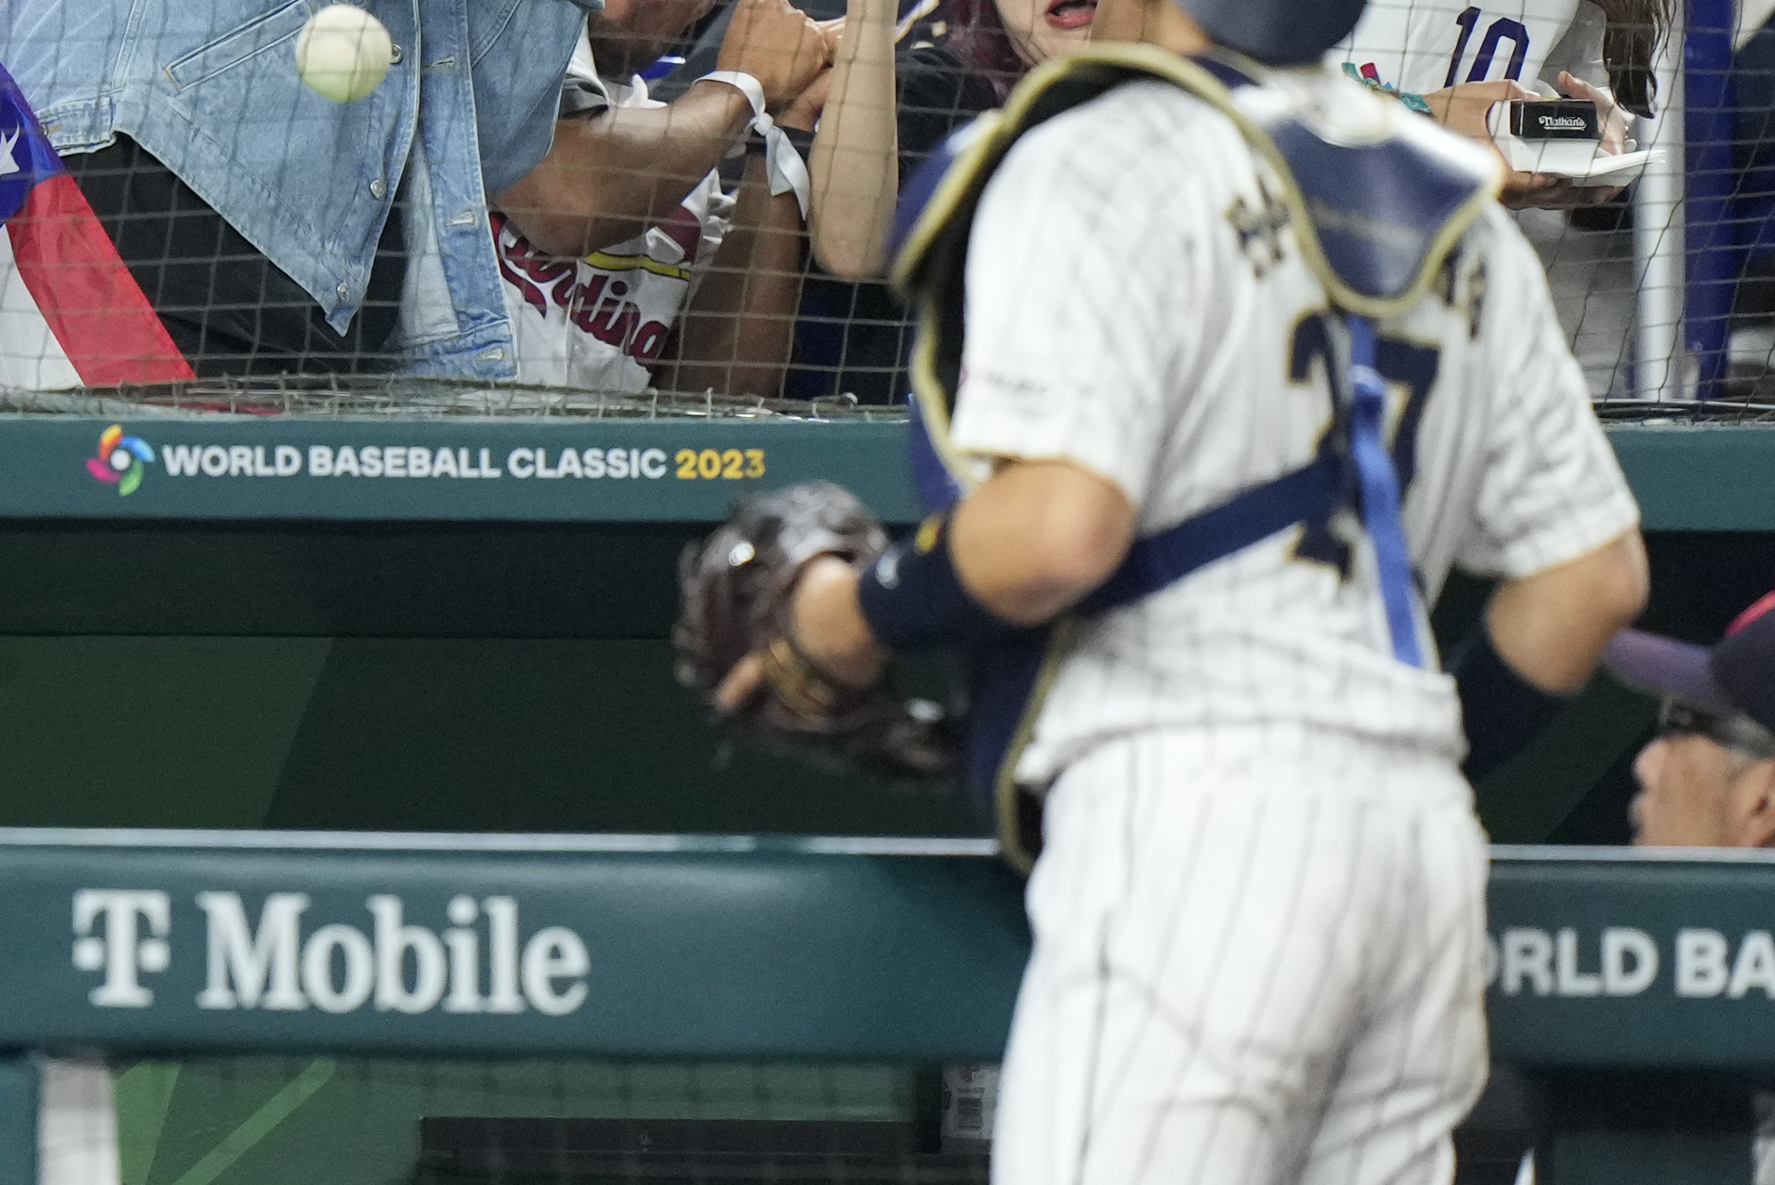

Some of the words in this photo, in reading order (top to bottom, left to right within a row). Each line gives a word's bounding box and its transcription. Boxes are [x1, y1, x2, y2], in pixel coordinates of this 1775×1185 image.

[1444, 5, 1530, 89] 10
[1538, 115, 1587, 130] Nathan's
[161, 444, 303, 478] WORLD
[308, 445, 502, 479] BASEBALL
[507, 447, 667, 480] CLASSIC
[675, 448, 766, 481] 2023
[71, 888, 172, 1009] T
[194, 890, 591, 1016] Mobile
[1487, 926, 1660, 997] RLD
